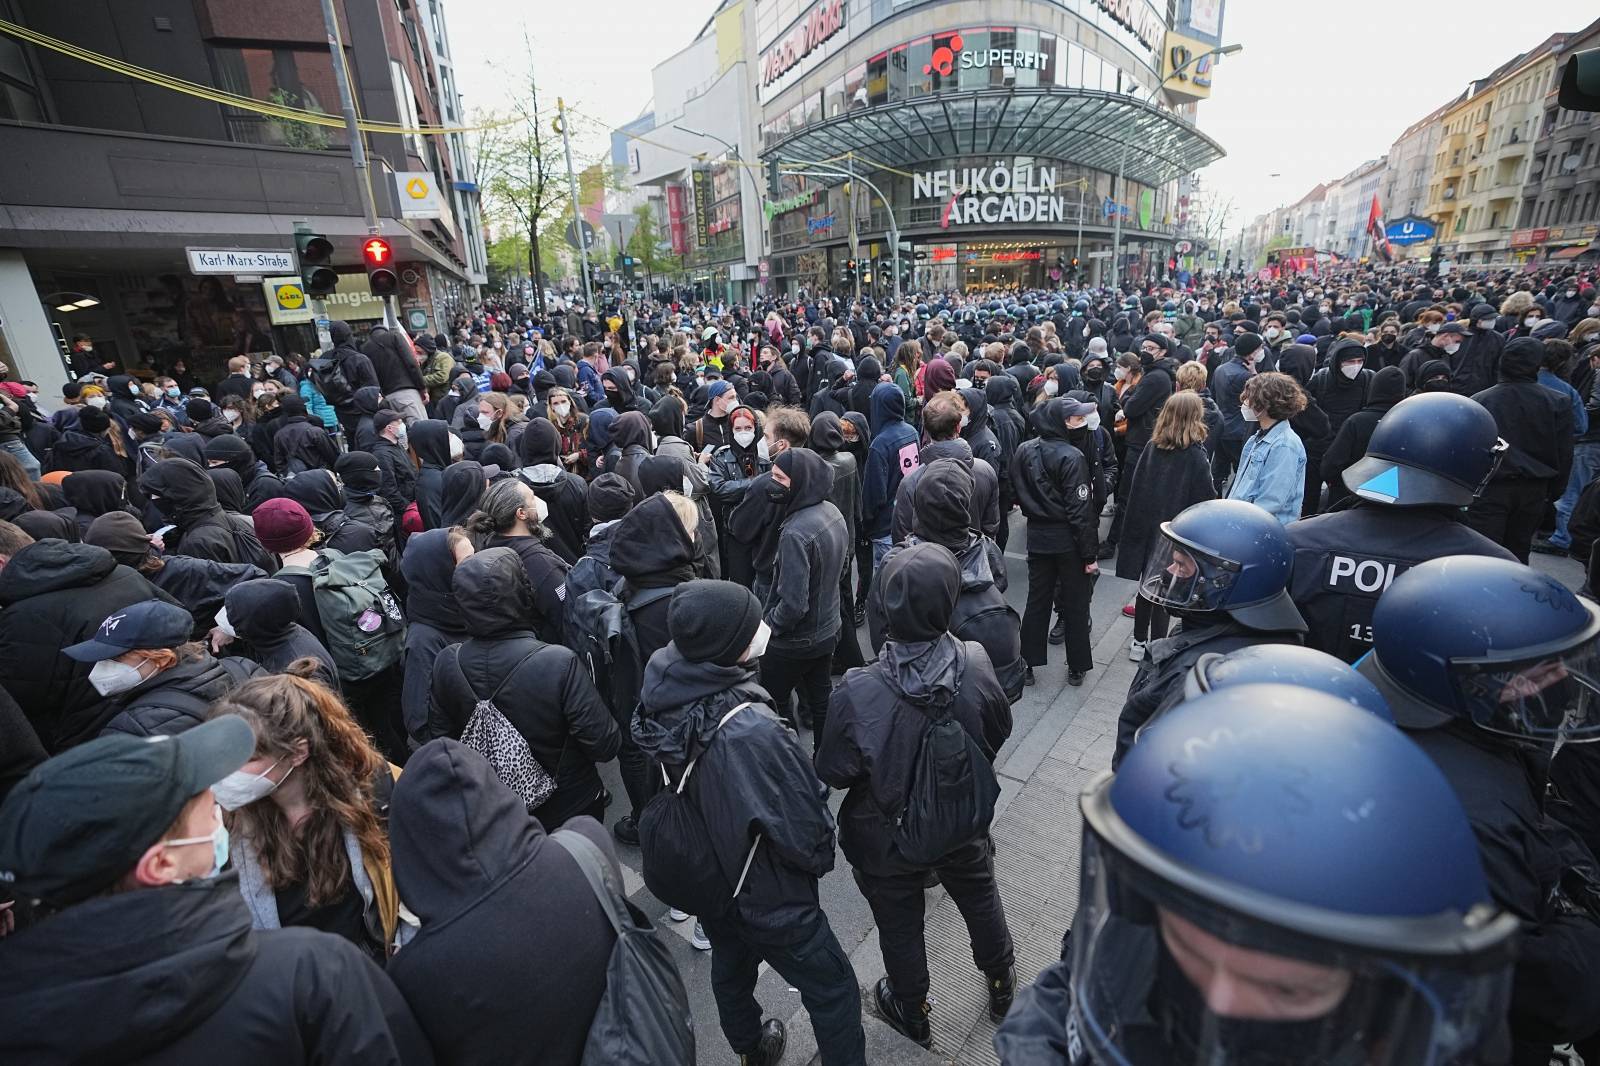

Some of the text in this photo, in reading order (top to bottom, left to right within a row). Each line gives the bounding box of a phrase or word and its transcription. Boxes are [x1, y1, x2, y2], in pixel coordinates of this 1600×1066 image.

[961, 49, 1049, 71] SUPERFIT
[941, 194, 1064, 229] ARCADEN
[1402, 222, 1415, 234] U
[198, 252, 289, 268] Karl-Marx-Straße
